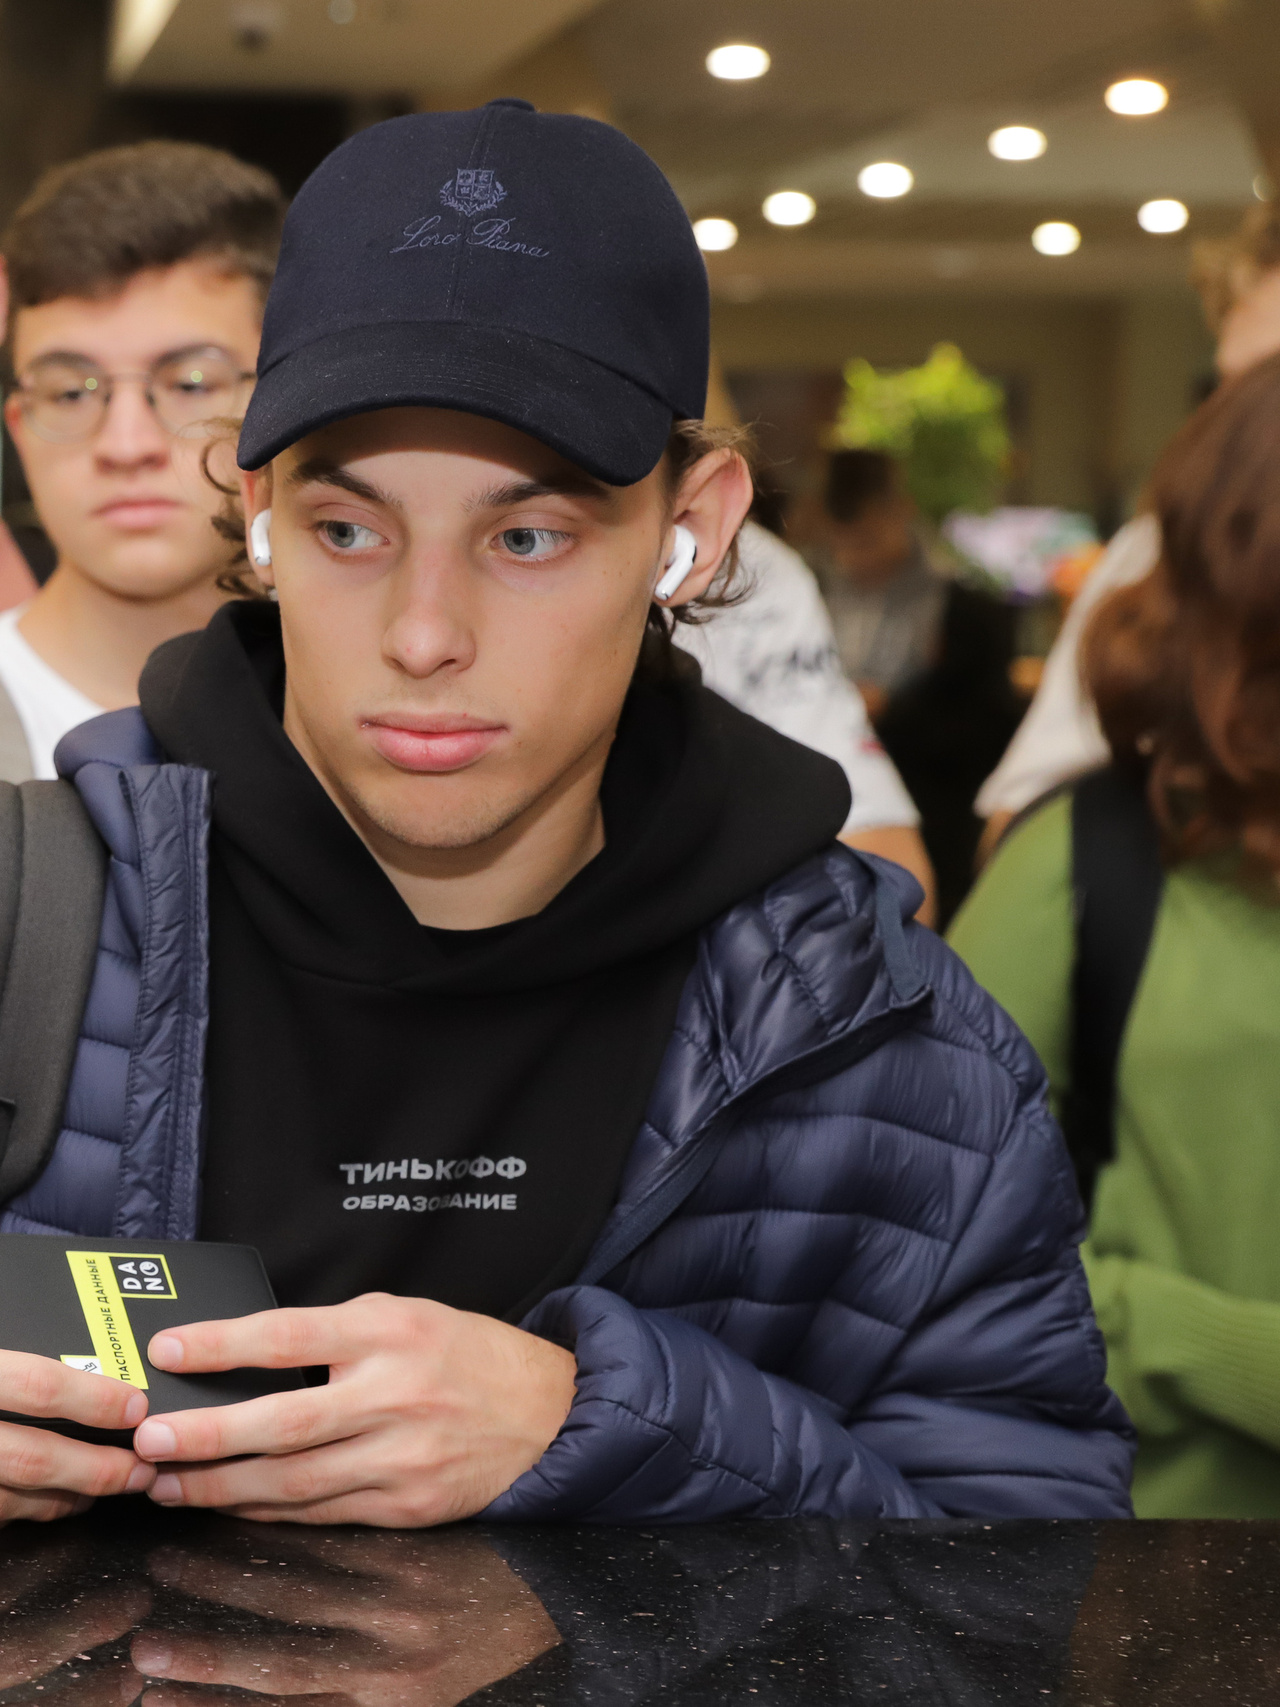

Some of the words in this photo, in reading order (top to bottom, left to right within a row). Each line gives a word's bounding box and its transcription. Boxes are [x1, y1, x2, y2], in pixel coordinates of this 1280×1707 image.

[389, 215, 461, 254] Loro
[466, 217, 549, 257] Piana
[339, 1155, 527, 1185] ТИНЬКОФФ
[86, 1258, 110, 1304] ДАННЫЕ
[100, 1307, 131, 1381] ПАСПОРТНЫЕ
